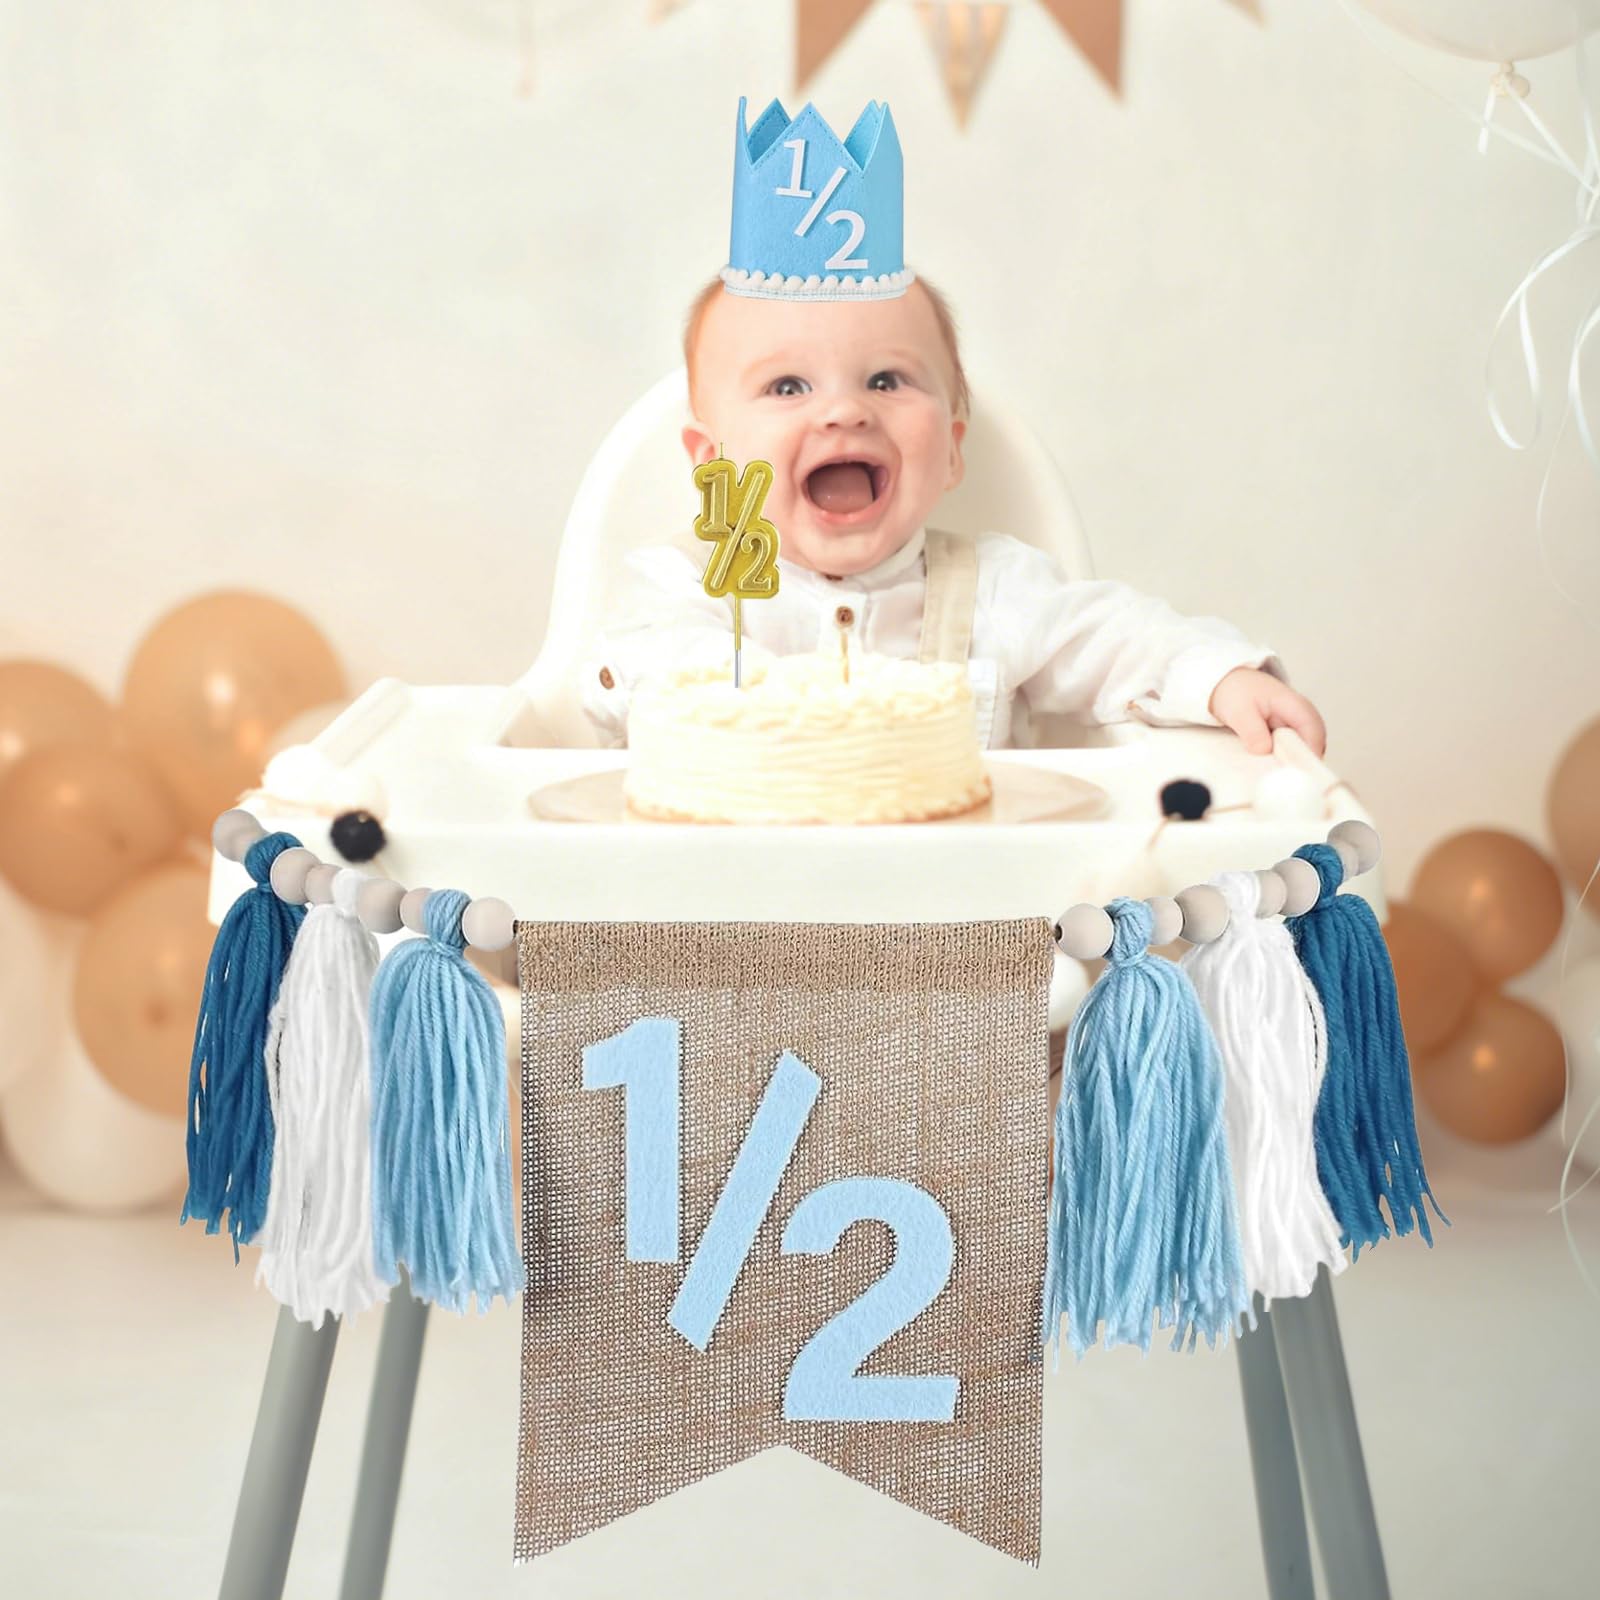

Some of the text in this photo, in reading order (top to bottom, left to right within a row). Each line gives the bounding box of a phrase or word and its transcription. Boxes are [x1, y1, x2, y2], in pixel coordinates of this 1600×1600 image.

[775, 138, 869, 270] 1/2
[702, 470, 772, 591] 1/2
[581, 1017, 962, 1421] 1/2
